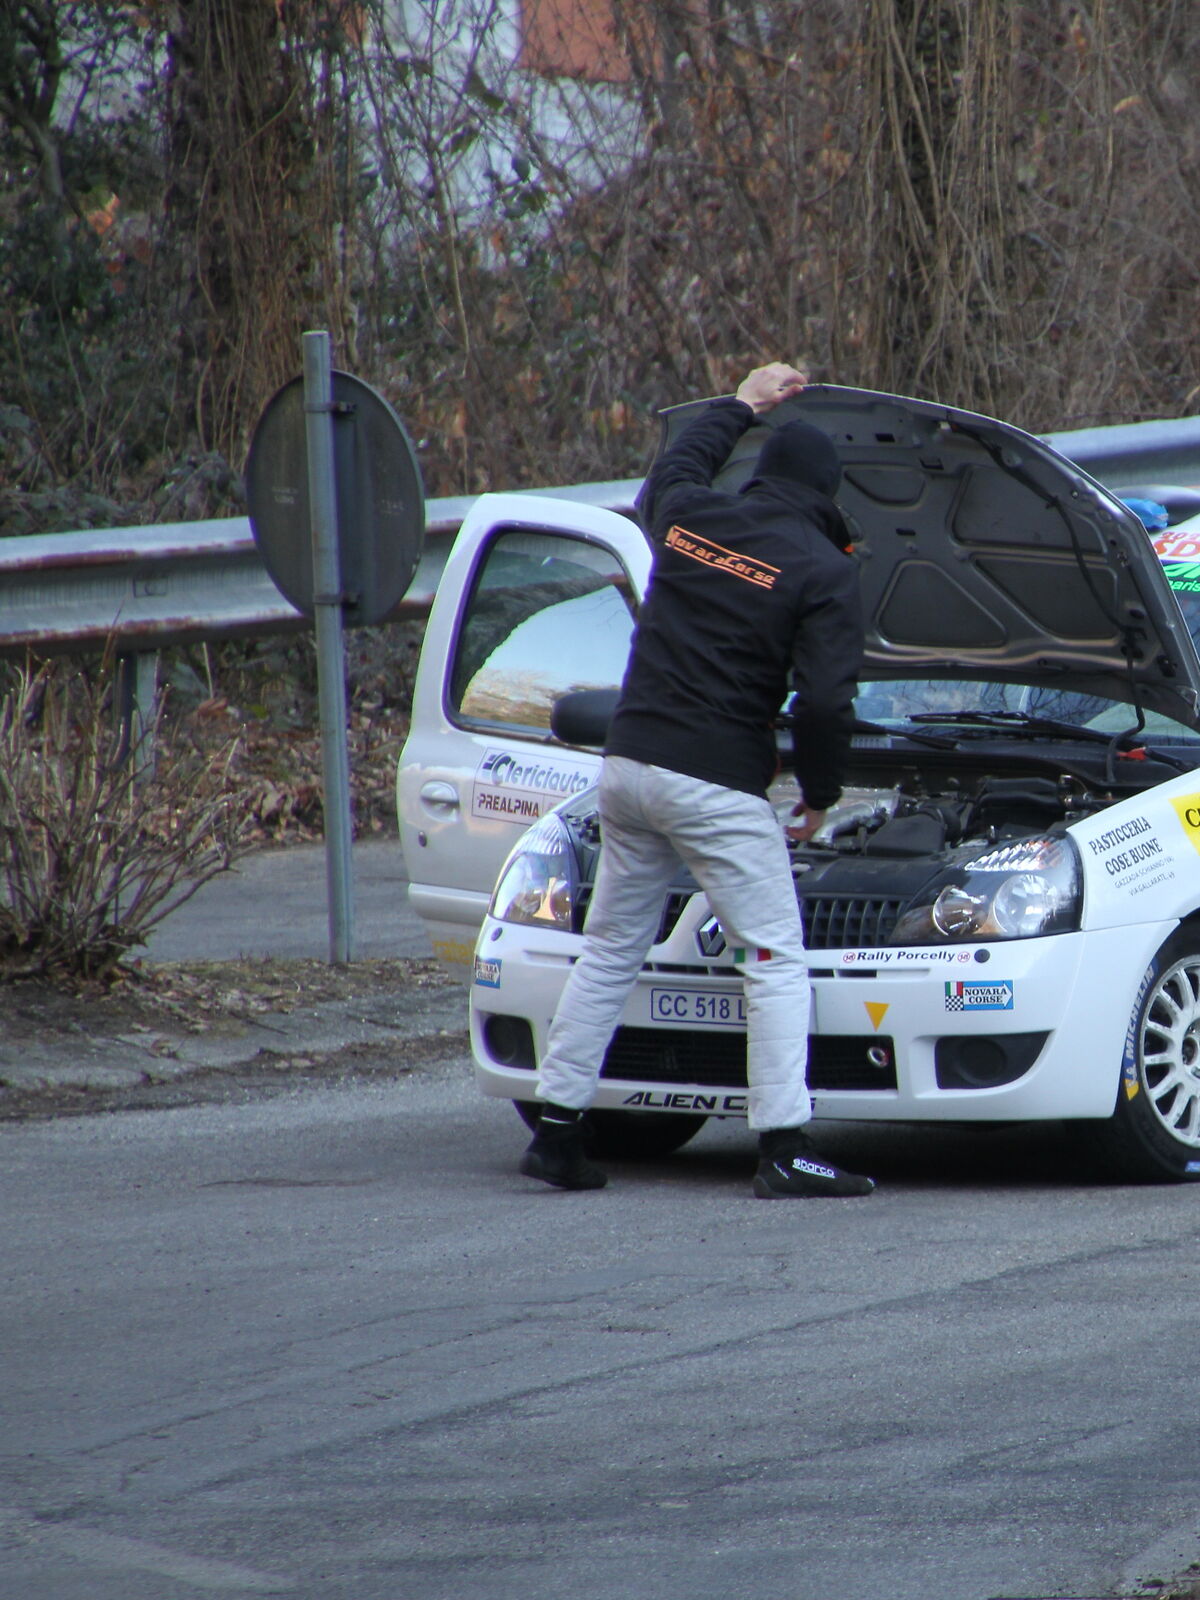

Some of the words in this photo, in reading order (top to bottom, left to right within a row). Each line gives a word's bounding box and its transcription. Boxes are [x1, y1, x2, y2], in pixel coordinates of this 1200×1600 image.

[491, 754, 588, 794] Clericiauto
[478, 793, 539, 818] PREALPINA
[1088, 816, 1152, 856] PASTICCERIA
[1105, 852, 1132, 876] COSE
[1129, 838, 1163, 864] BUONE
[857, 951, 893, 964] Rally
[896, 951, 956, 964] Porcelly
[964, 987, 1008, 997] NOVARA
[968, 995, 1004, 1005] CORSE
[658, 994, 688, 1017] CC
[695, 997, 730, 1019] 518
[737, 998, 749, 1020] L
[1125, 964, 1155, 1060] MICHELIN
[623, 1091, 716, 1110] ALIEN
[792, 1157, 836, 1179] sparco
